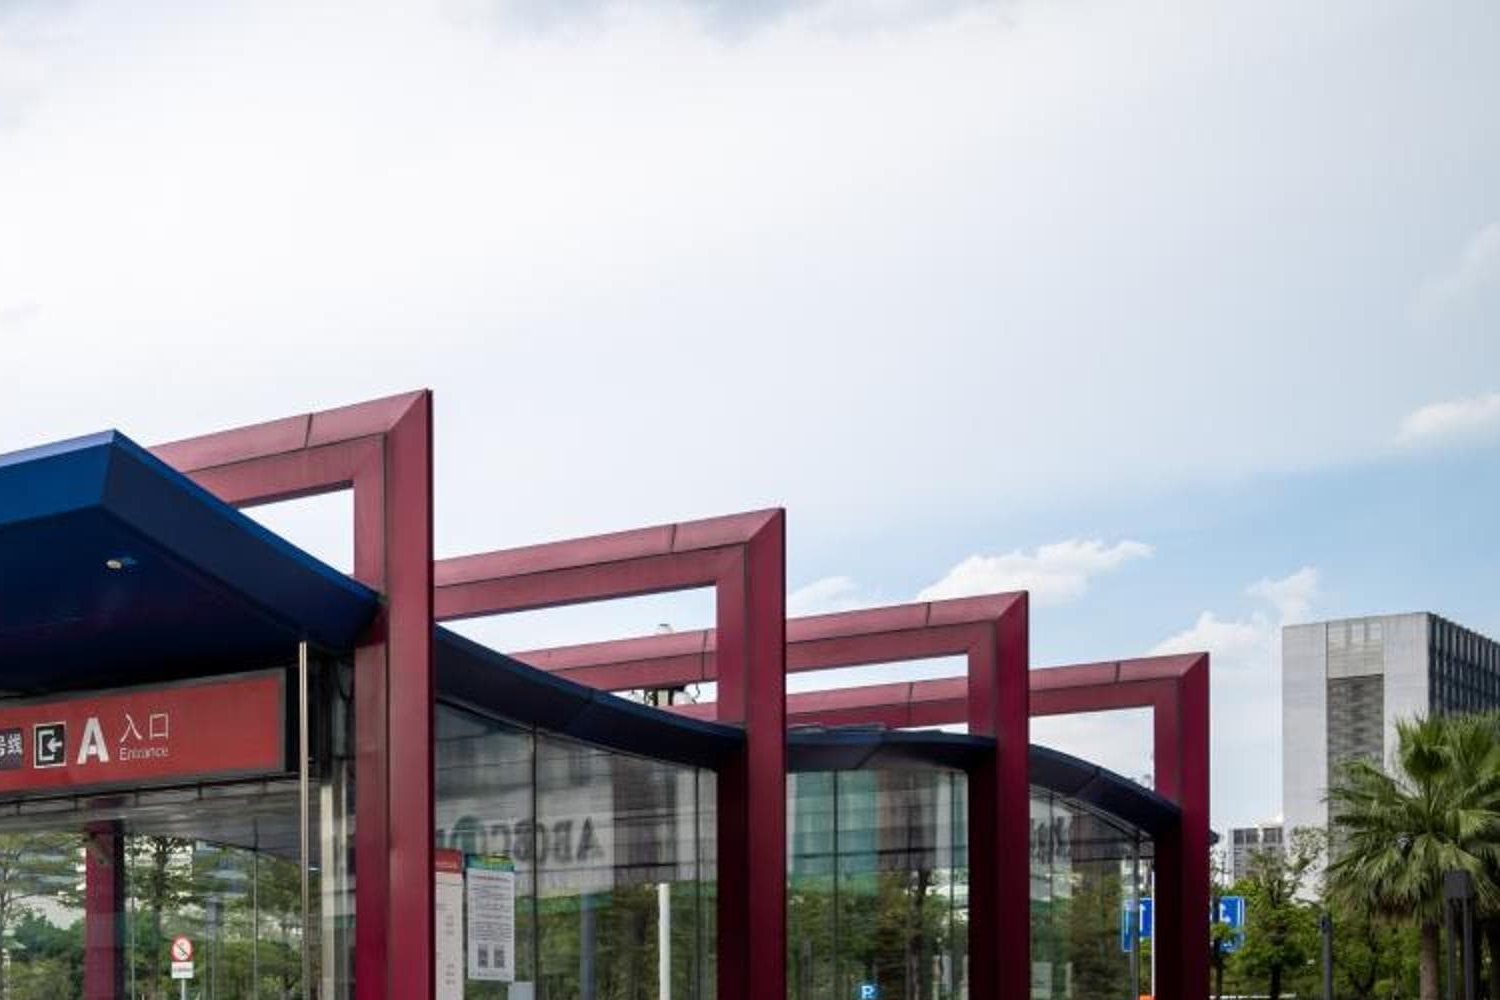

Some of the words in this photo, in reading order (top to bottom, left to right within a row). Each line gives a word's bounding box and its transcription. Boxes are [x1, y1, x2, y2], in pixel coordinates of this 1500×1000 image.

[77, 716, 110, 765] A
[119, 713, 169, 743] 入口
[861, 985, 875, 1000] P
